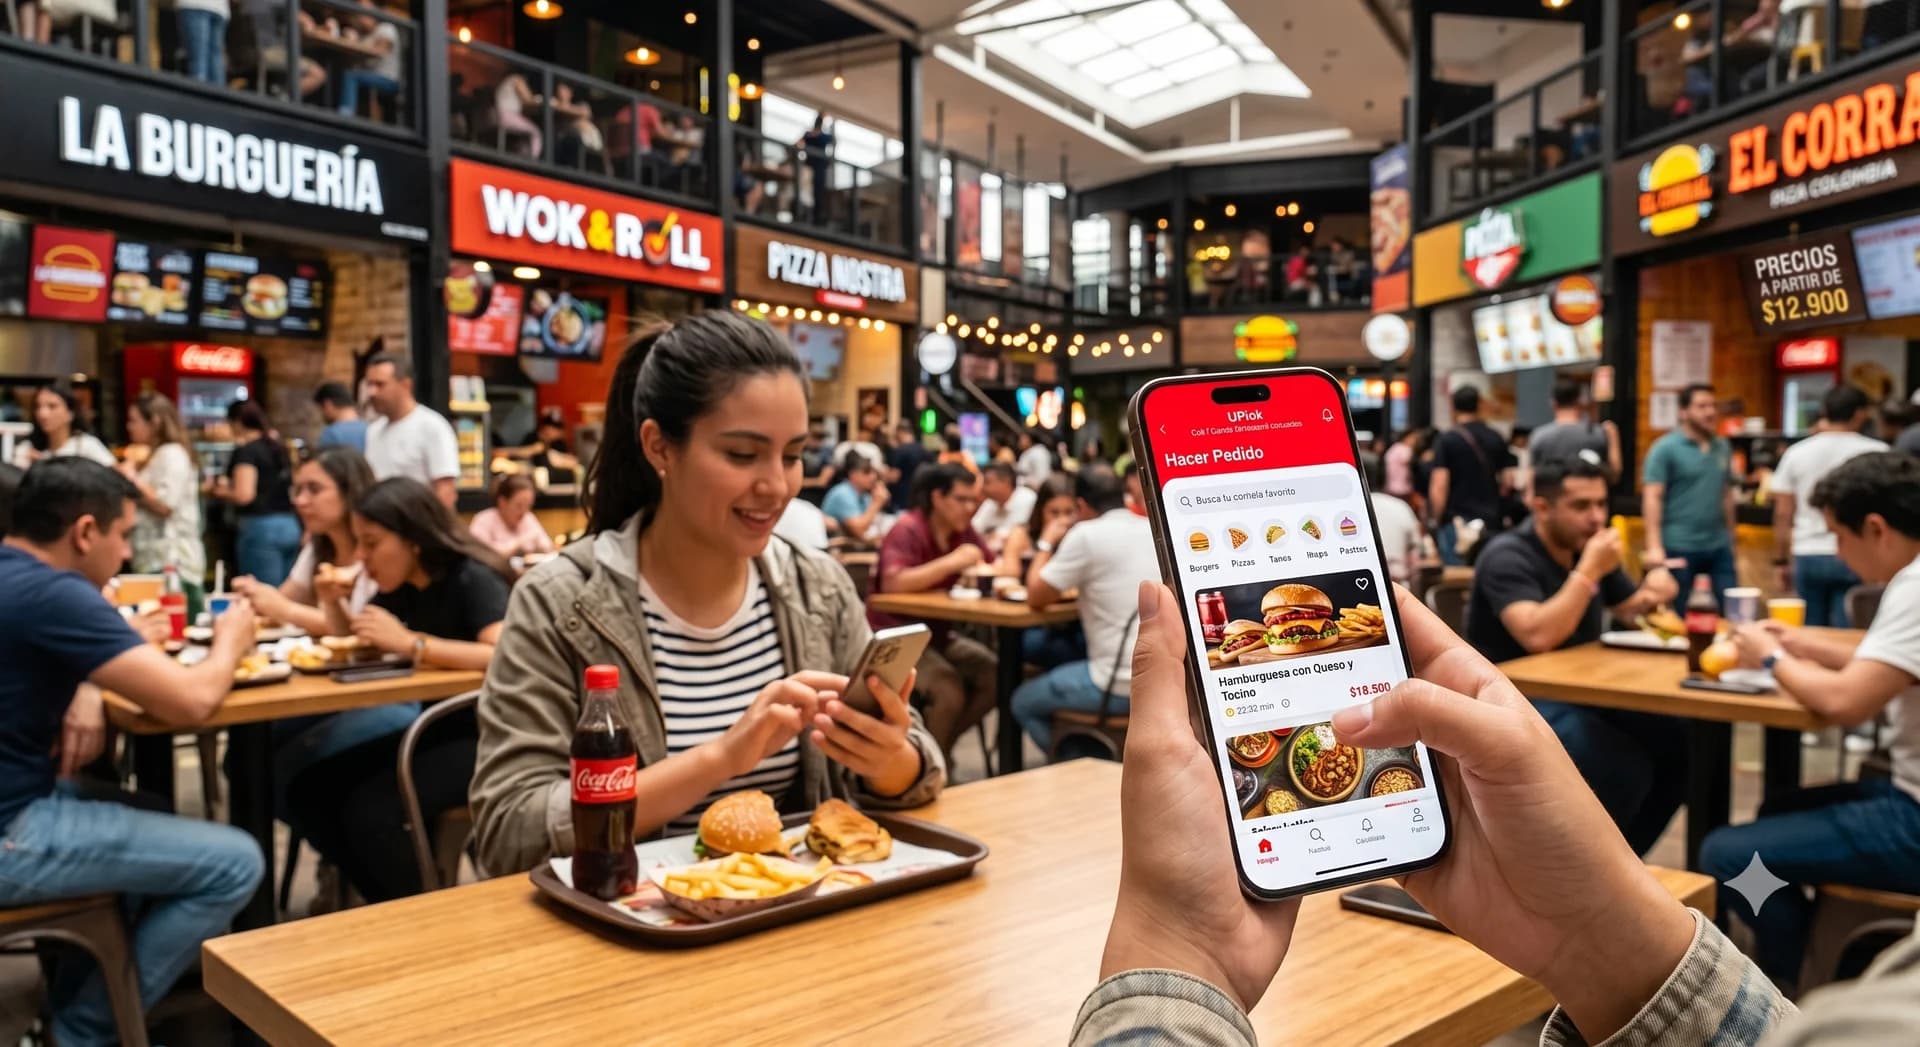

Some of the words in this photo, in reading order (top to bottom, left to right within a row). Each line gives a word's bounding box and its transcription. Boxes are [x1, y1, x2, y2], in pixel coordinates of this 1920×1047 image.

[61, 96, 131, 171] LA
[138, 112, 385, 216] BURGUERÍA
[1728, 124, 1777, 194] EL
[768, 240, 830, 289] PIZZA
[1754, 243, 1838, 279] PRECIOS
[1760, 281, 1771, 297] A
[1772, 273, 1821, 295] PARTIR
[1822, 268, 1843, 286] DE
[1761, 288, 1849, 325] $12.900
[1165, 451, 1209, 467] Hacer
[1213, 444, 1264, 463] Pedido
[1196, 494, 1221, 505] Busca
[1223, 493, 1232, 502] tu
[1265, 488, 1296, 498] favorito
[1231, 558, 1256, 568] Pizzas
[1218, 669, 1290, 688] Hamburguesa
[1292, 665, 1312, 677] con
[1313, 661, 1346, 674] Queso
[1345, 659, 1354, 670] y
[1221, 688, 1257, 702] Tocino
[1349, 681, 1391, 698] $18.500
[1259, 702, 1275, 712] min
